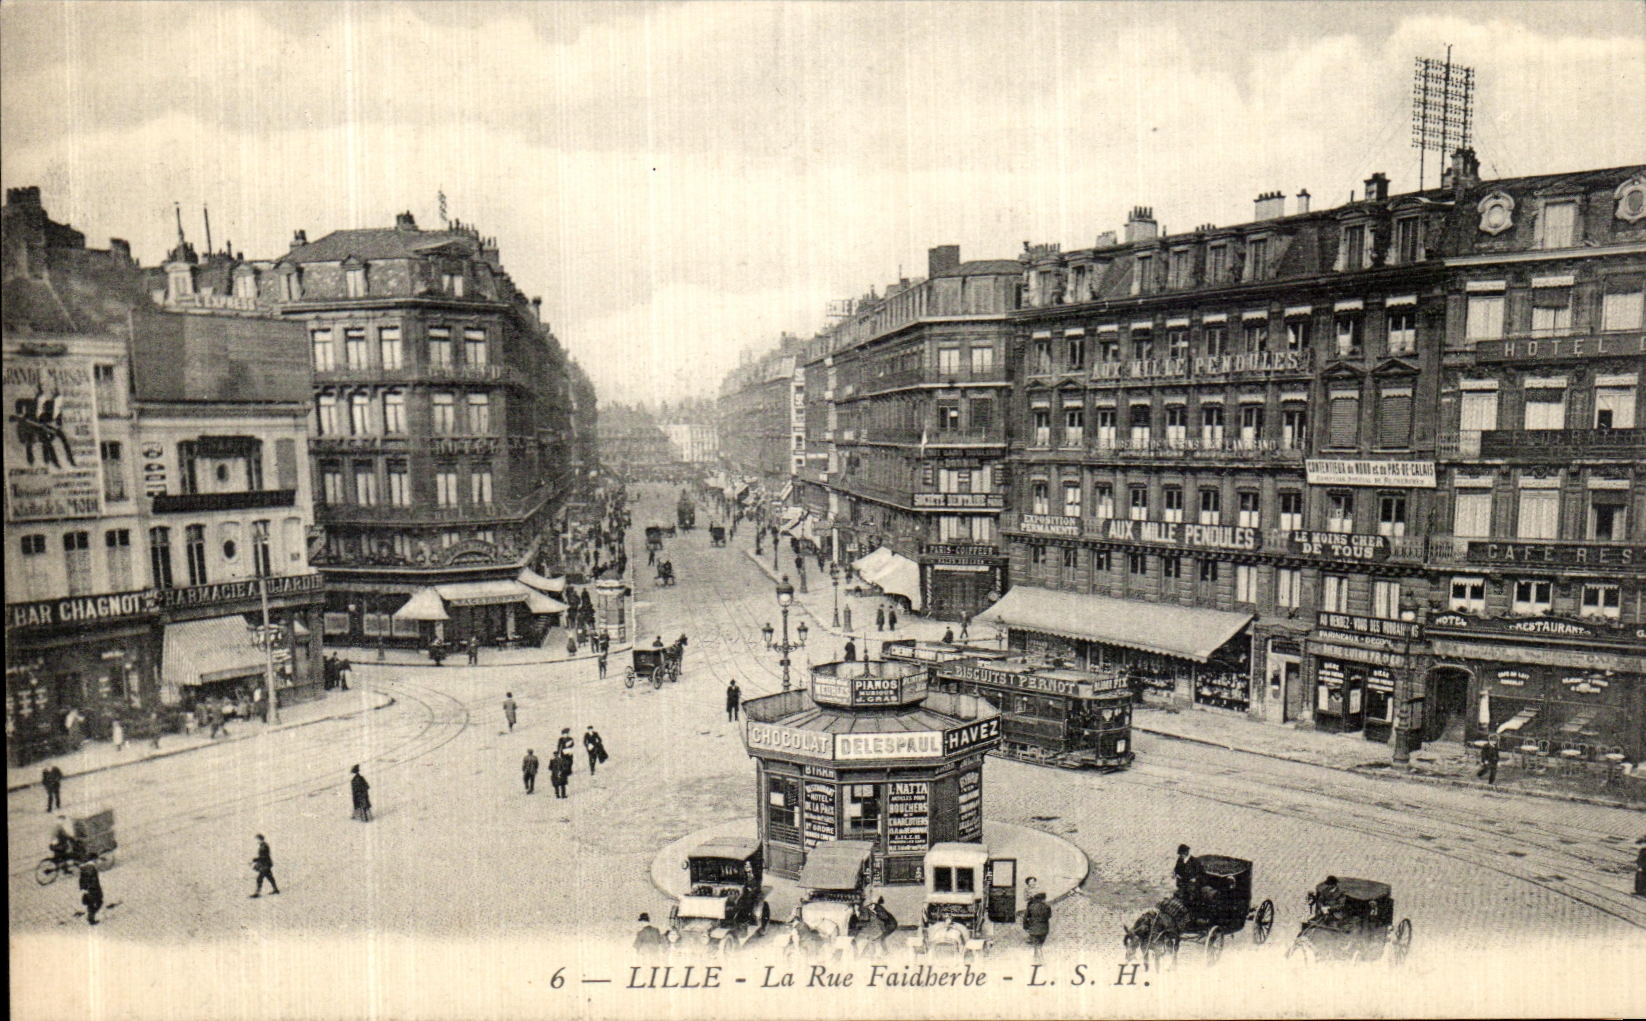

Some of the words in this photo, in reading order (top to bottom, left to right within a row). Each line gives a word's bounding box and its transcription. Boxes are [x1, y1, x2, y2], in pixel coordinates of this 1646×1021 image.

[1504, 338, 1608, 357] HOTEL
[1091, 360, 1121, 379] AUX
[1132, 357, 1185, 377] MILLE
[1194, 351, 1299, 375] PENDULES
[1020, 522, 1080, 535] PERMANENTE
[1023, 513, 1077, 526] EXPOSITION
[1108, 519, 1135, 540] AUX
[1140, 521, 1177, 543] MILLE
[1185, 526, 1255, 549] PENDULES
[1294, 531, 1308, 543] LE
[1311, 532, 1348, 545] MOINS
[1351, 534, 1385, 548] CHER
[1302, 542, 1323, 555] DE
[1331, 545, 1374, 559] TOUS
[1487, 544, 1555, 562] CAFE
[1576, 547, 1646, 565] RES
[260, 575, 323, 594] UJARDIN
[14, 604, 53, 627] BAR
[59, 594, 141, 622] CHAGNOT
[1435, 615, 1467, 627] HOTEL
[1514, 620, 1586, 635] RESTAURANT
[855, 680, 898, 691] PIANOS
[954, 665, 1009, 685] BISCUITS
[1018, 674, 1077, 694] PERNOT
[751, 726, 830, 755] CHOCOLAT
[840, 735, 939, 756] DELESPAUL
[949, 719, 999, 750] HAVEZ
